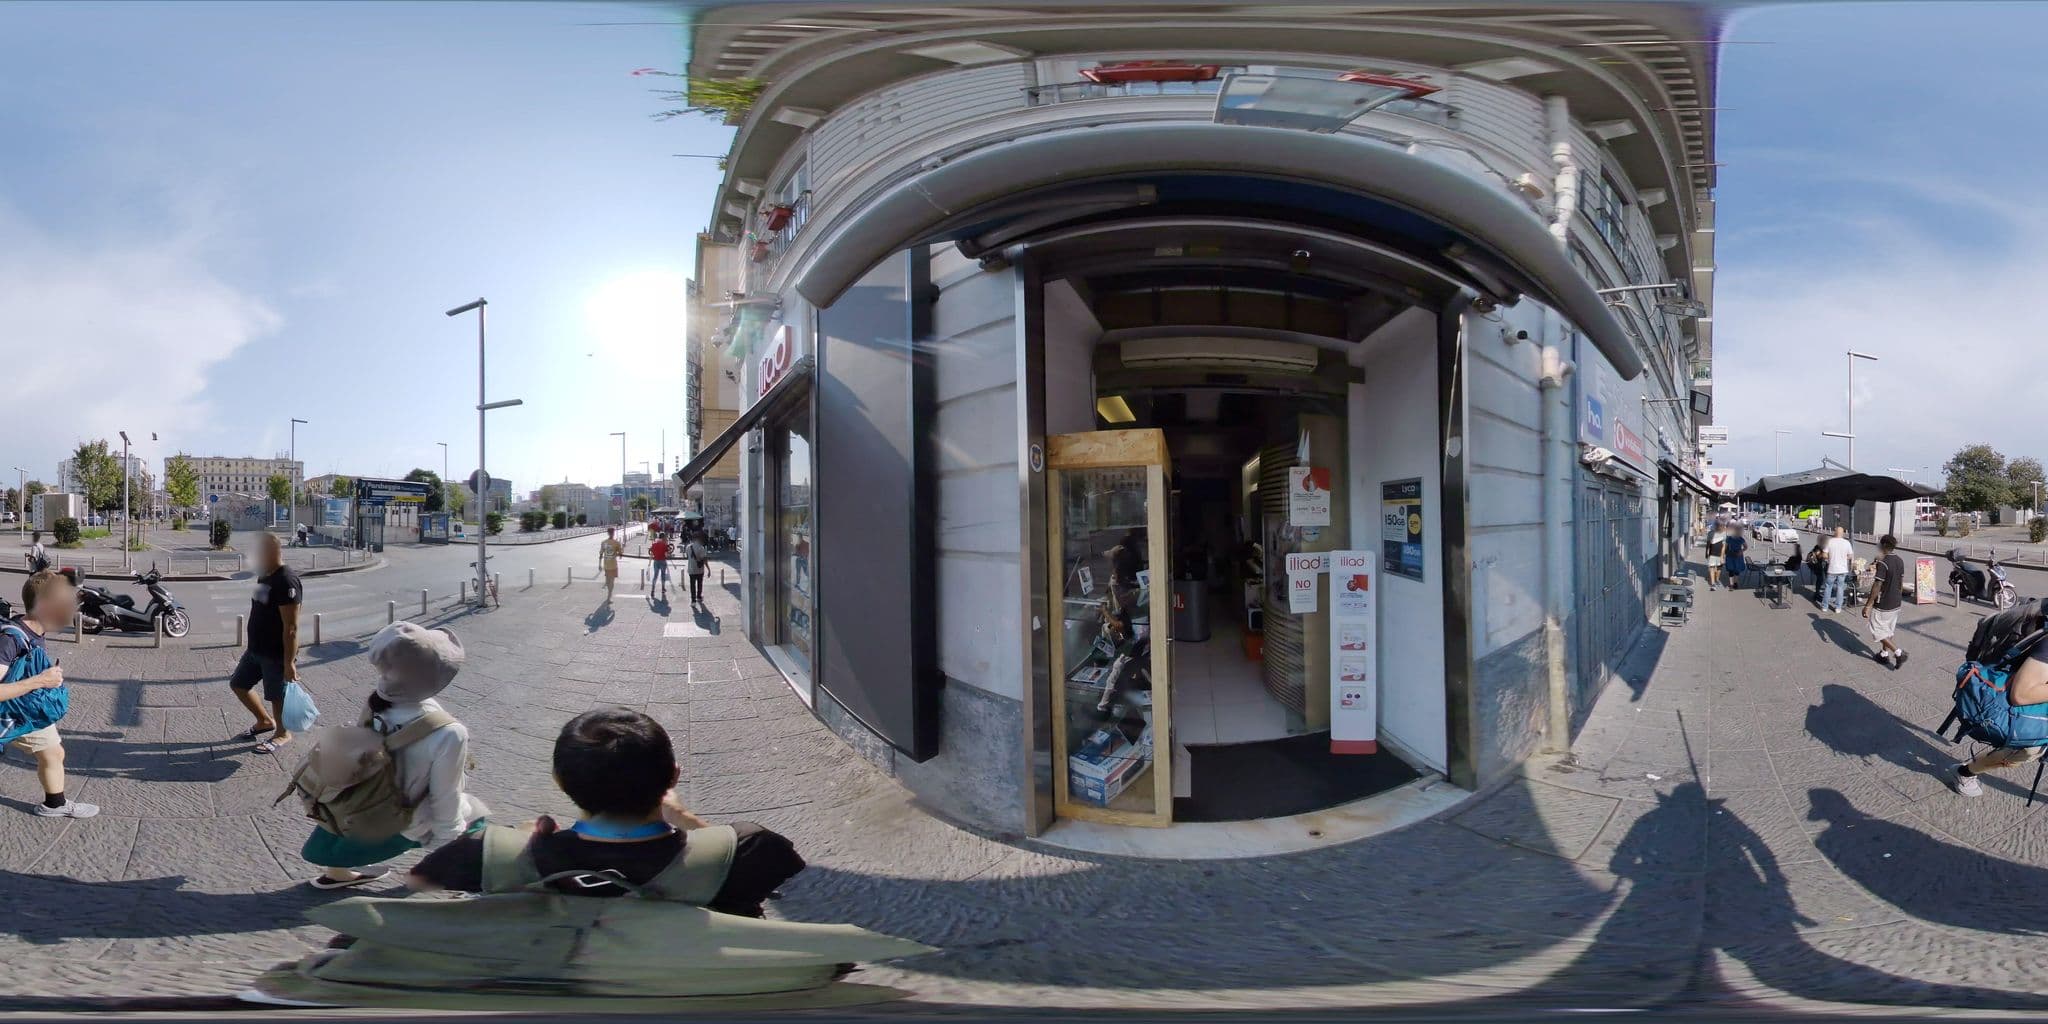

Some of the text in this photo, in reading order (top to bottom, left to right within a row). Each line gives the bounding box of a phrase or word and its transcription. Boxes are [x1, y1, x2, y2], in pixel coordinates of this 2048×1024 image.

[758, 325, 792, 399] iliad
[1289, 556, 1321, 571] iliad
[1340, 556, 1365, 567] iliad
[1295, 580, 1311, 589] NO
